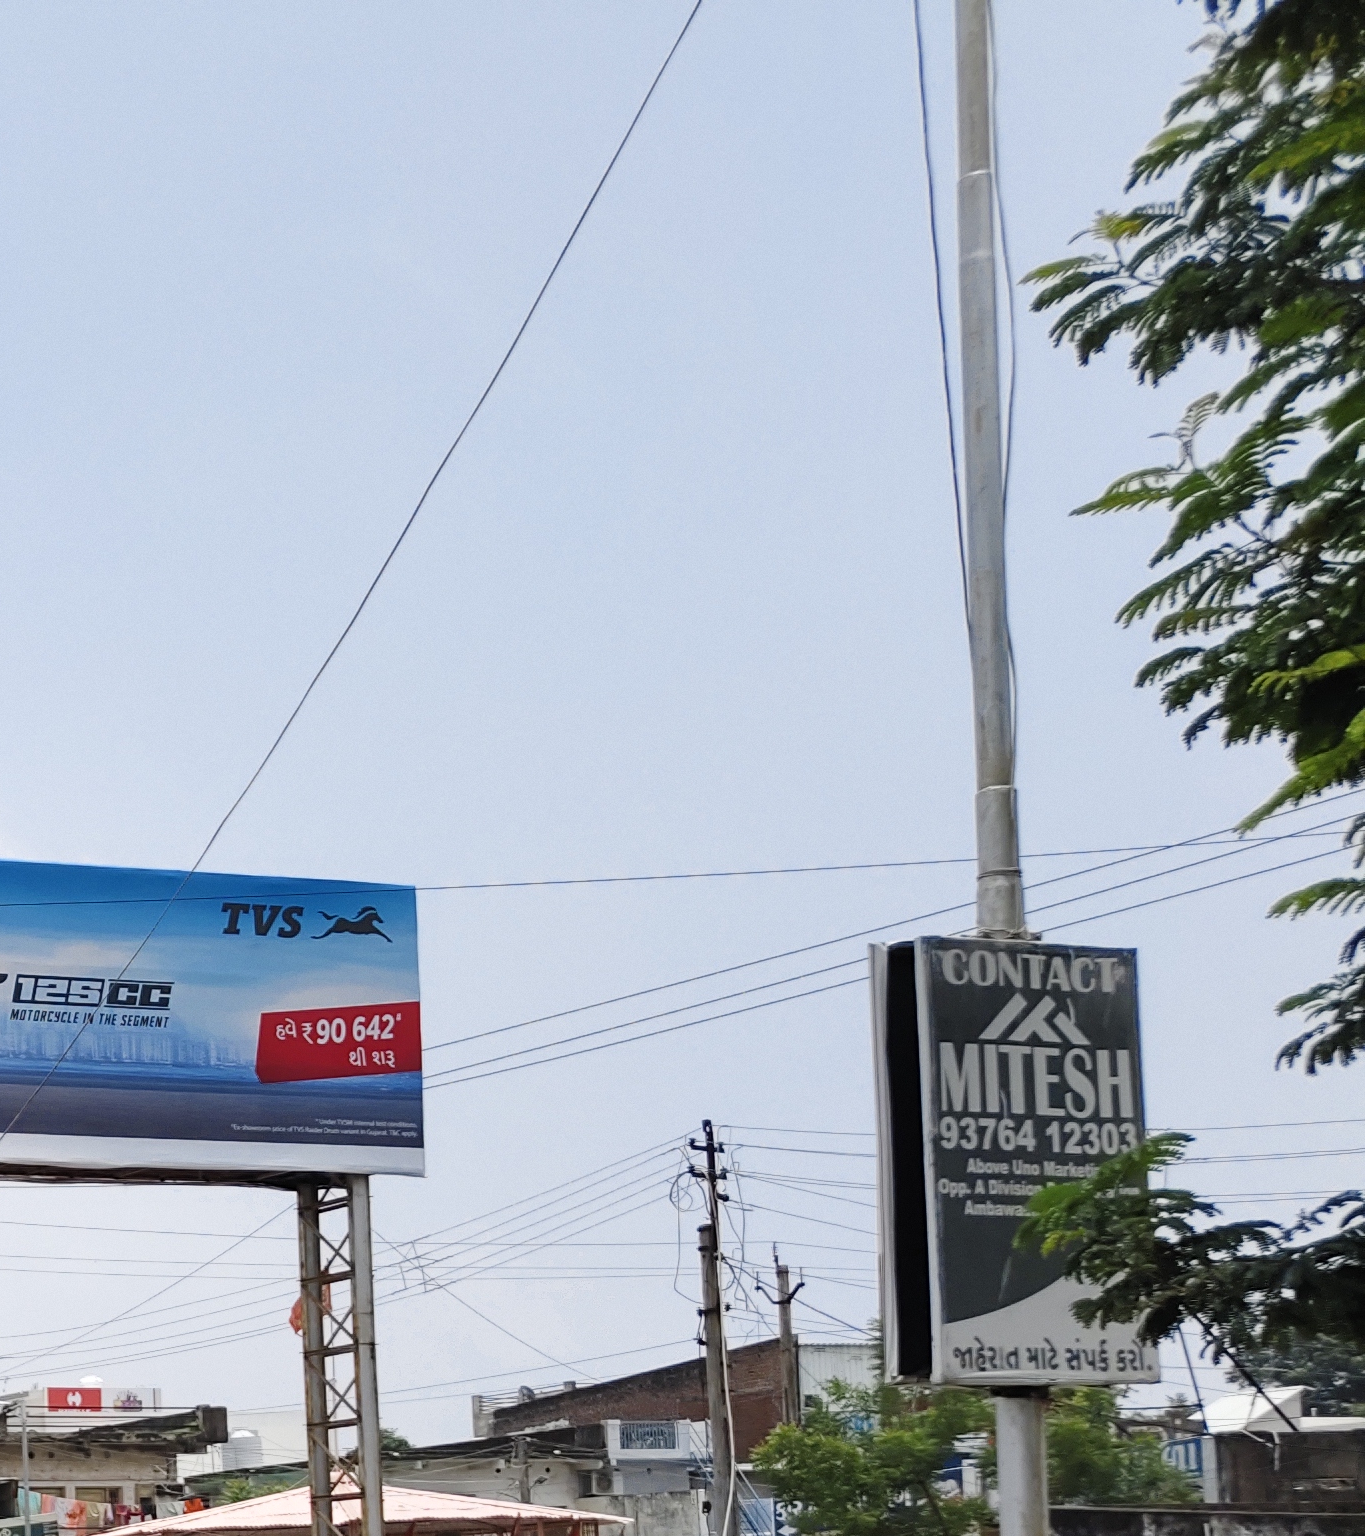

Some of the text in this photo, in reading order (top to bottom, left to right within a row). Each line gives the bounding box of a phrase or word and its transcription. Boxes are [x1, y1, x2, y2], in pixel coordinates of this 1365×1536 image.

[221, 902, 305, 938] TVS
[940, 947, 1119, 994] CONTACT
[10, 1008, 170, 1028] MOTORCYCLE IN THE SEGMENT
[348, 1046, 367, 1067] થી
[939, 1040, 1135, 1120] MITESH
[939, 1116, 1137, 1156] 93764 12303
[966, 1158, 1010, 1175] Above
[1012, 1159, 1040, 1176] Uno
[937, 1178, 971, 1198] Opp.
[974, 1179, 985, 1195] A
[952, 1335, 1019, 1372] જાહેરાત
[1026, 1337, 1059, 1371] માટે
[1065, 1337, 1110, 1372] સંપર્ક
